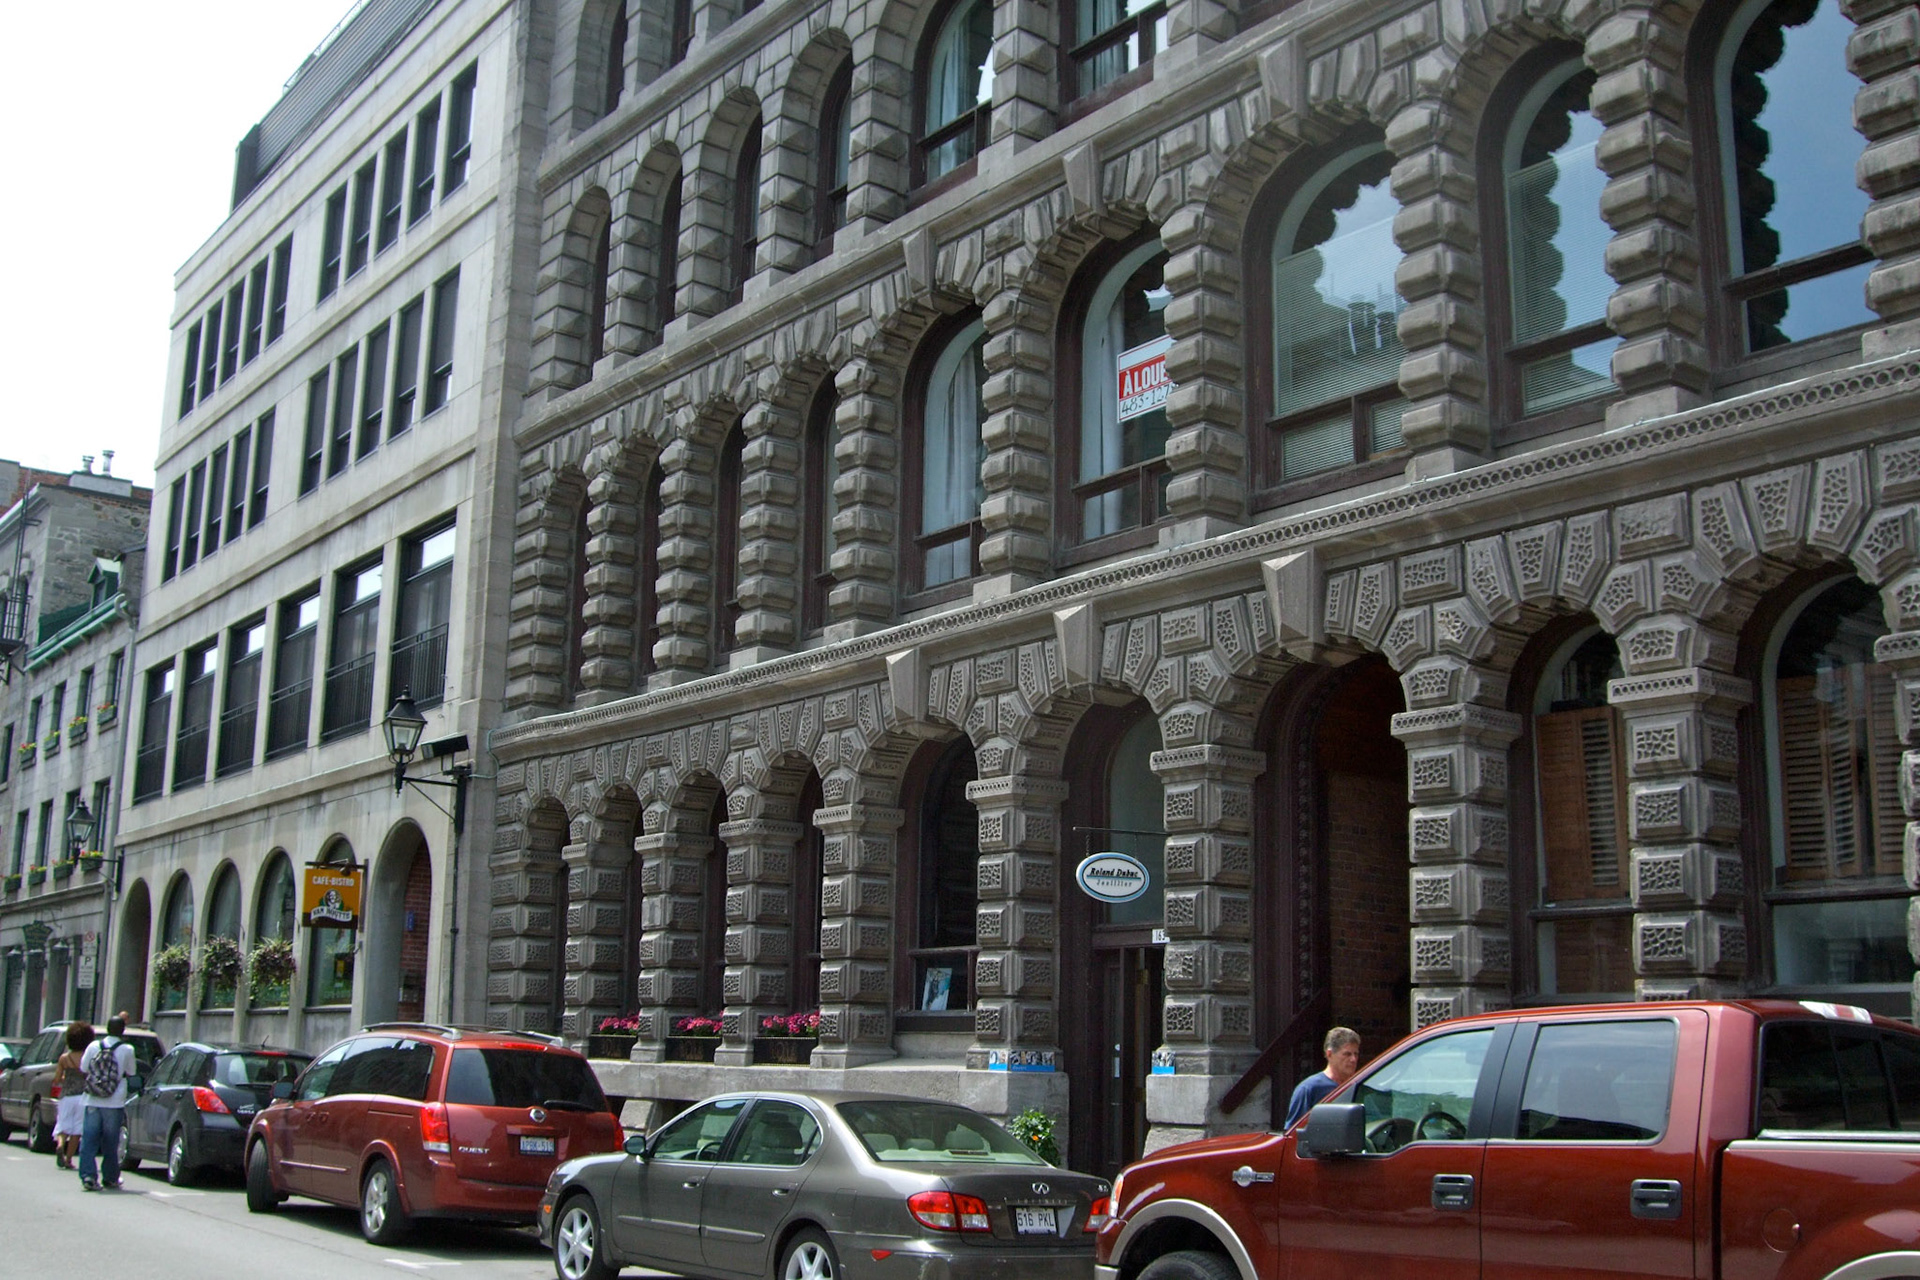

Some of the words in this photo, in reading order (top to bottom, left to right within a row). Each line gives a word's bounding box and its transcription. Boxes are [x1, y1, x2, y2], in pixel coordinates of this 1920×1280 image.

[1123, 370, 1133, 397] À
[1133, 360, 1169, 392] LOUE
[1121, 382, 1171, 415] 483-127
[1090, 867, 1115, 877] Roland
[1116, 868, 1139, 878] Dubuc
[84, 956, 91, 965] P
[458, 1146, 490, 1155] QUEST
[1017, 1212, 1034, 1227] 516
[1038, 1213, 1055, 1227] PKL
